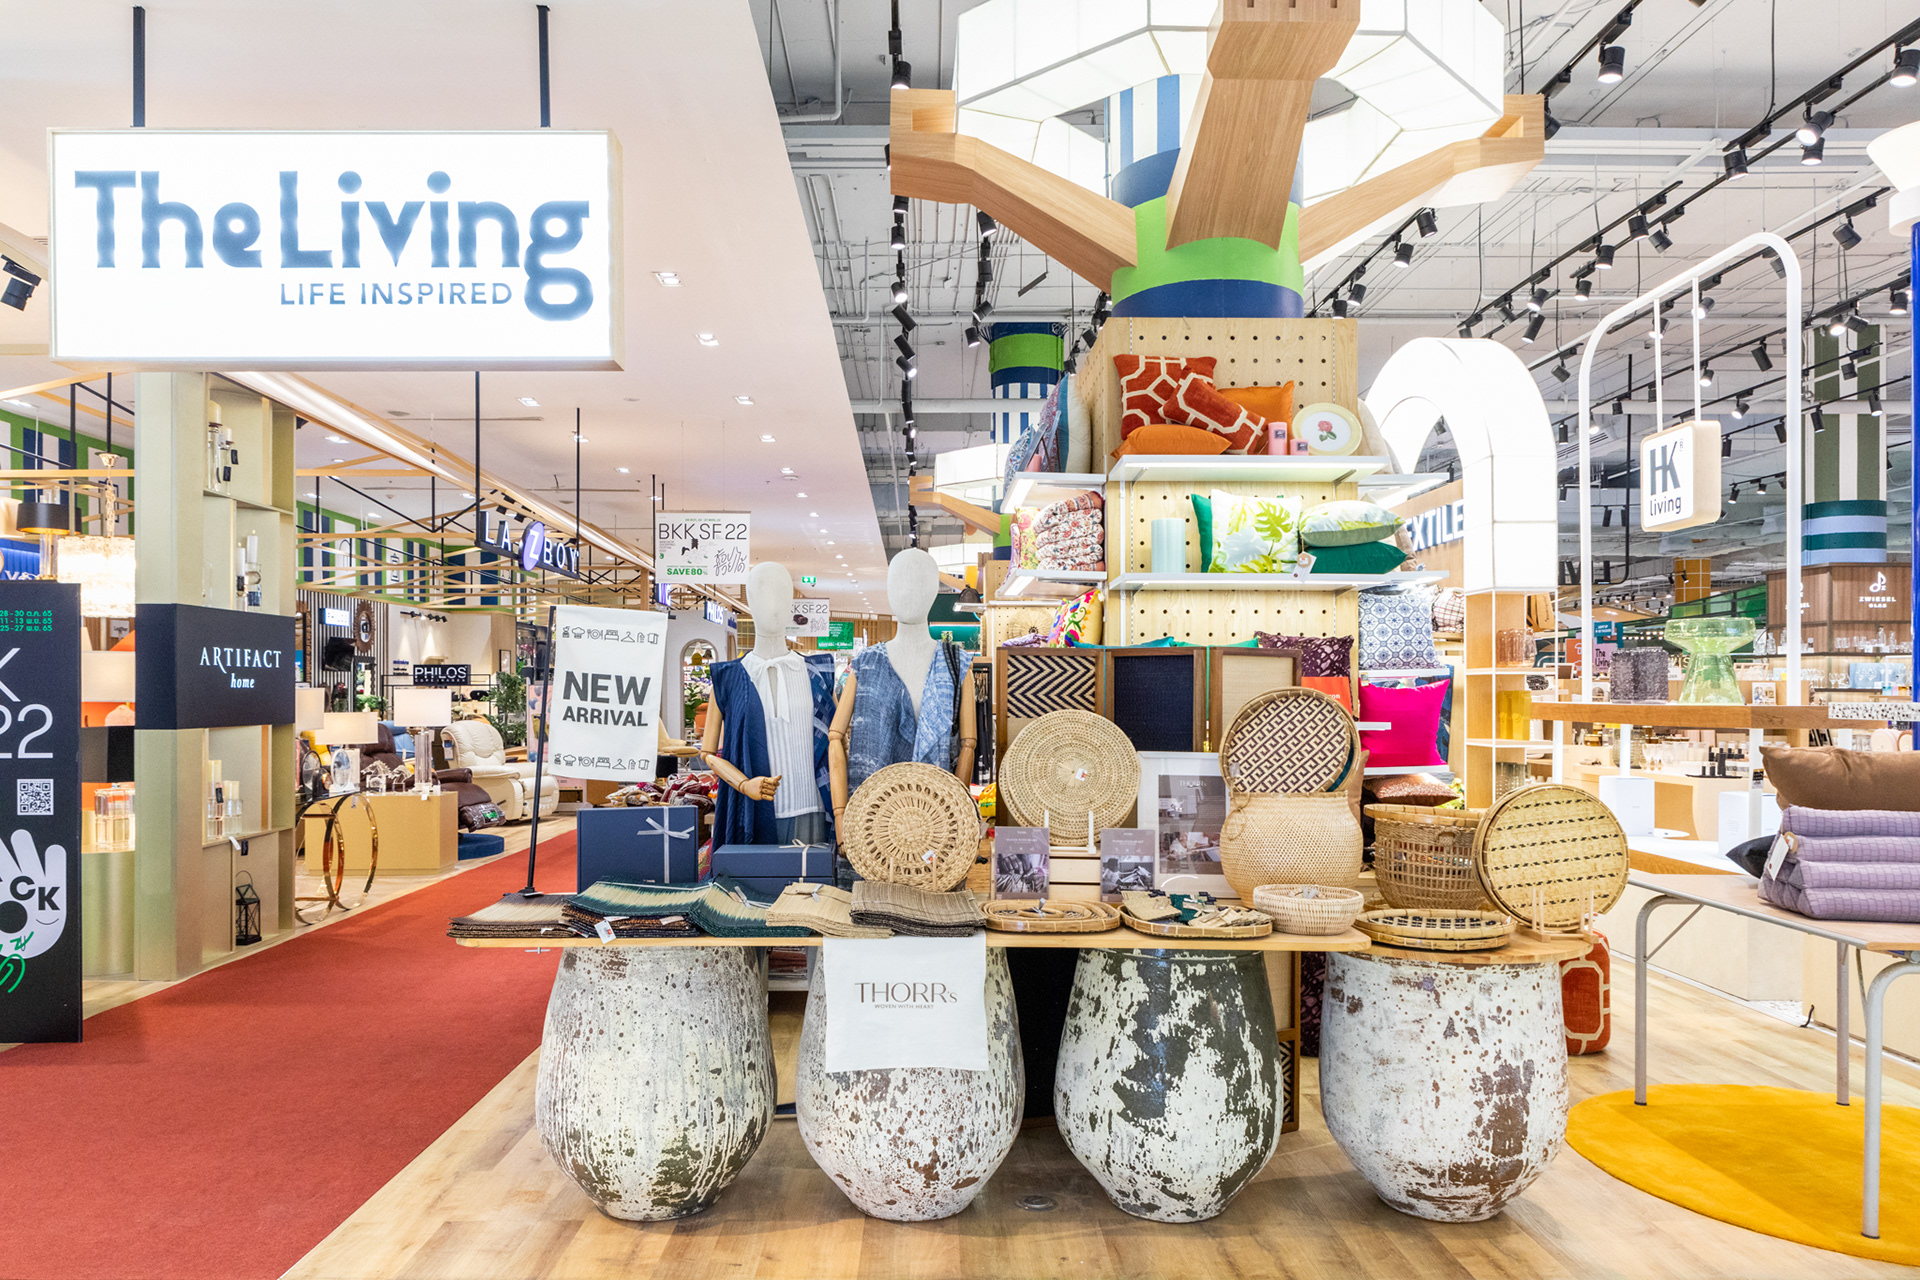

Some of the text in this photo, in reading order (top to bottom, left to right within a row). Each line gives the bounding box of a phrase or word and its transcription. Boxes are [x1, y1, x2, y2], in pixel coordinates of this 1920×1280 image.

[281, 283, 512, 305] LIFE INSPIRED
[1650, 440, 1681, 496] HK
[1650, 496, 1682, 516] living
[659, 523, 696, 540] BKK
[725, 523, 747, 540] 22
[1403, 499, 1464, 552] EXTILE
[543, 537, 576, 573] BOY
[199, 646, 282, 674] ARTIFACT
[230, 672, 255, 689] home
[414, 667, 467, 679] PHILOS
[562, 670, 651, 706] NEW
[562, 706, 649, 728] ARRIVAL
